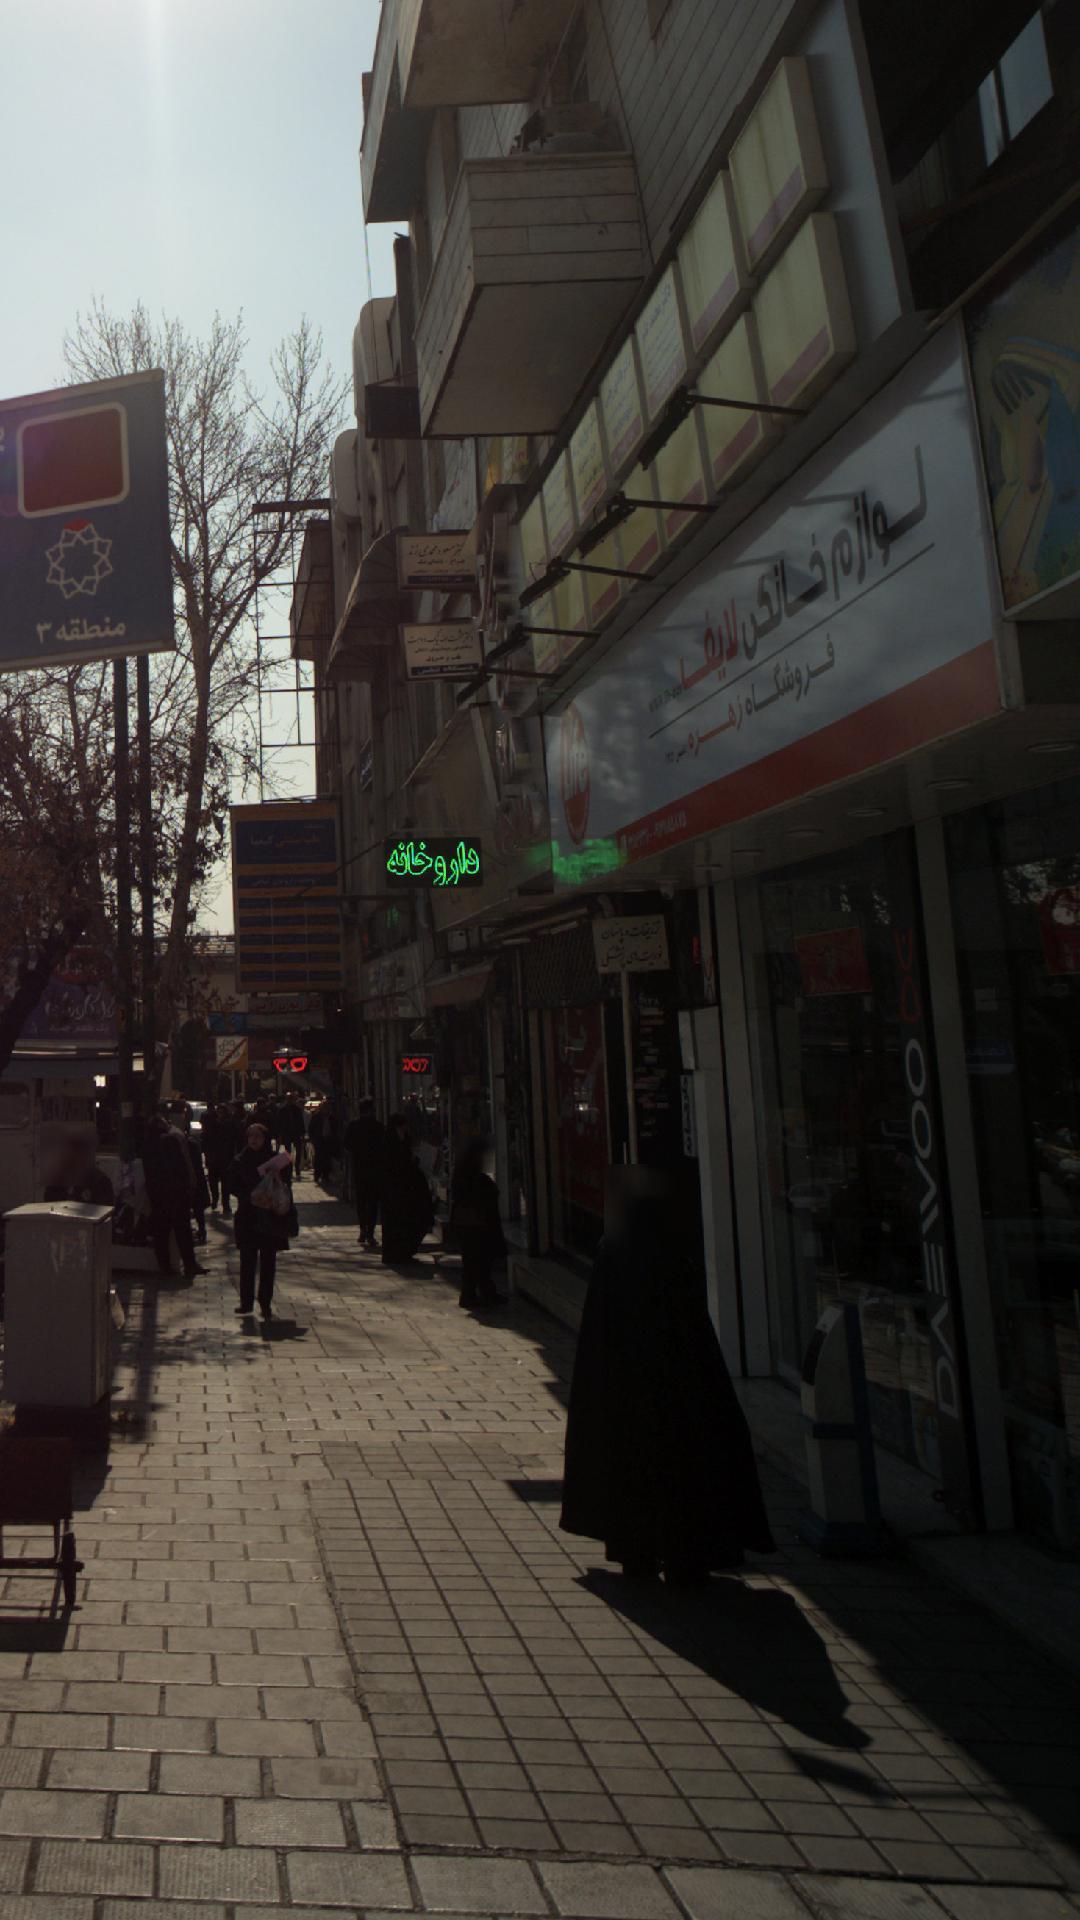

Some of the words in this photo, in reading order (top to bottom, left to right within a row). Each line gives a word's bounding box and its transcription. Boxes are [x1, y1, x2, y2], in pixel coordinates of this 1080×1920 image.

[831, 444, 927, 601] لوازم
[36, 621, 53, 645] ۳
[55, 617, 127, 641] منطقه
[741, 532, 828, 661] خانگی
[745, 632, 835, 717] فروشگاه
[688, 695, 743, 757] زهره
[386, 841, 480, 886] داروخانه
[905, 1038, 960, 1419] DAEWOO
